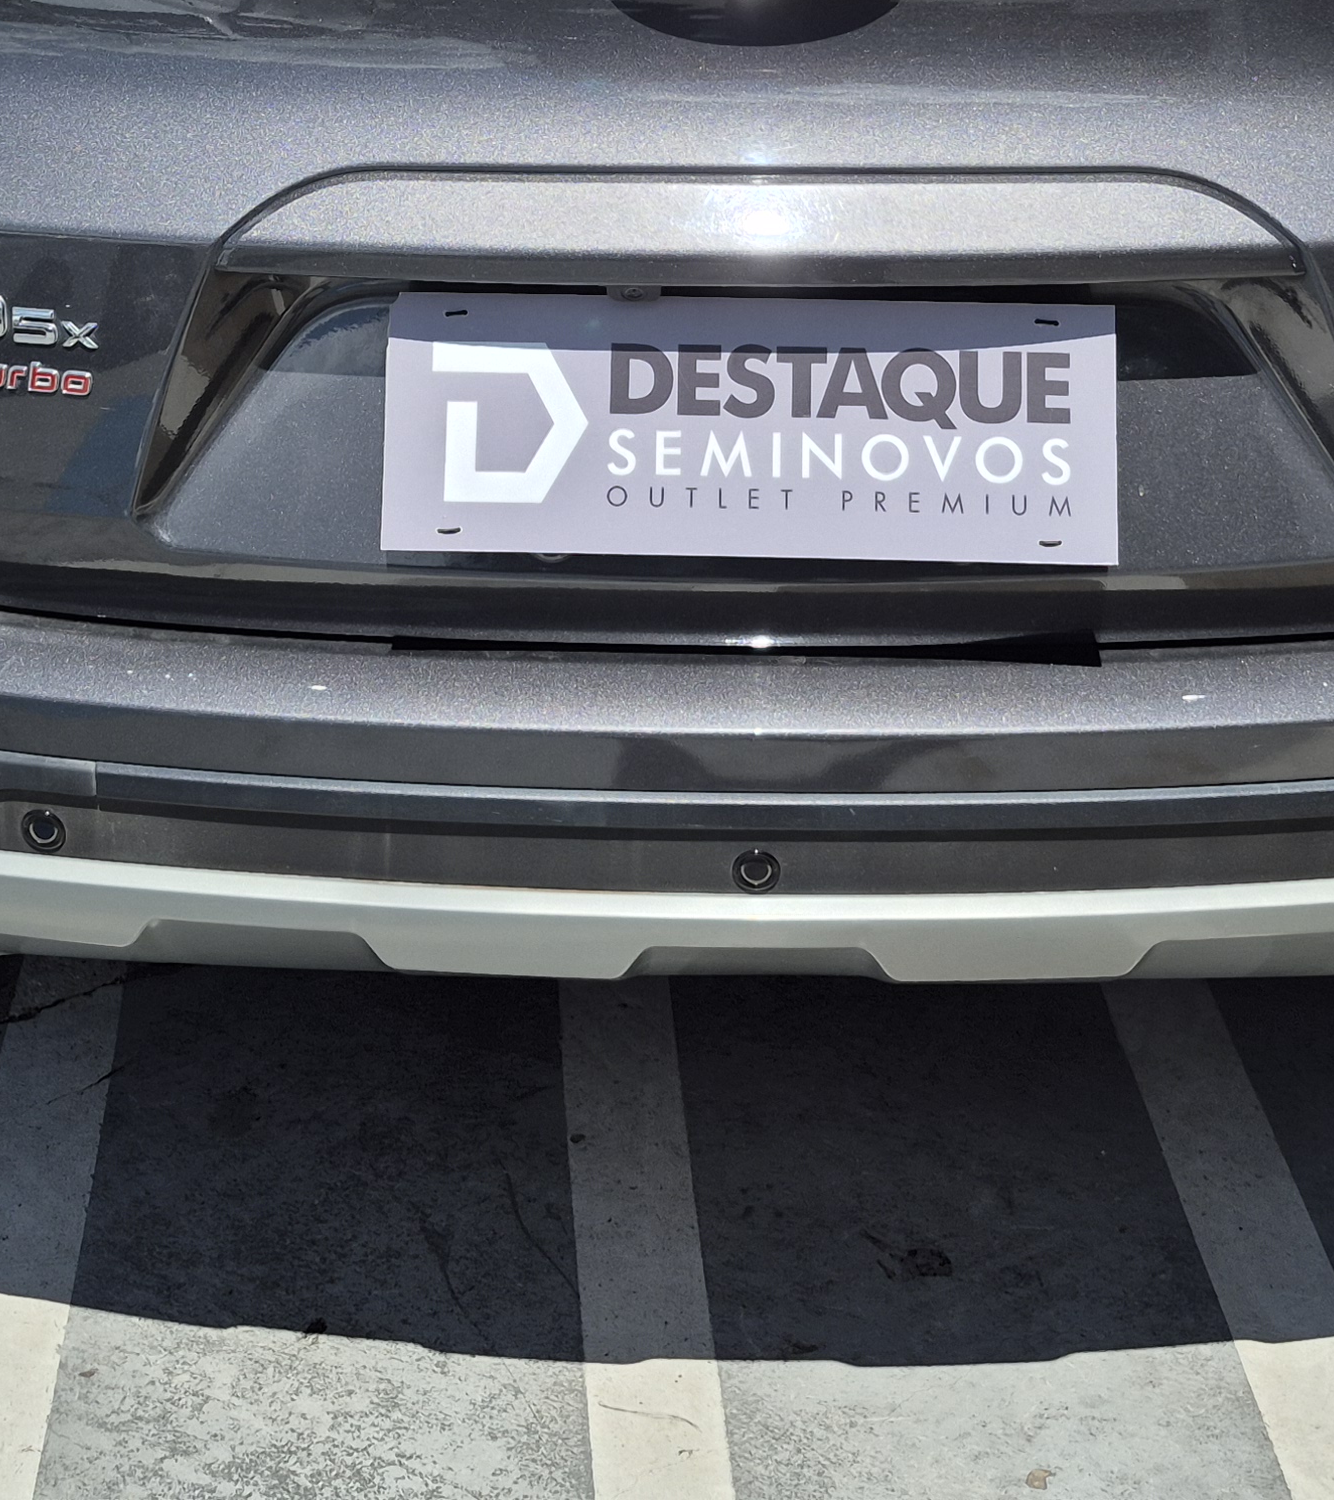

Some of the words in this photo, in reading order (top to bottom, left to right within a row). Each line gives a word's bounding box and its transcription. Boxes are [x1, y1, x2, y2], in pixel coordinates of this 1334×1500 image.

[608, 342, 1071, 429] DESTAQUE
[608, 428, 1071, 486] SEMINOVOS
[606, 484, 795, 512] OUTLET
[841, 489, 1072, 518] PREMIUM
